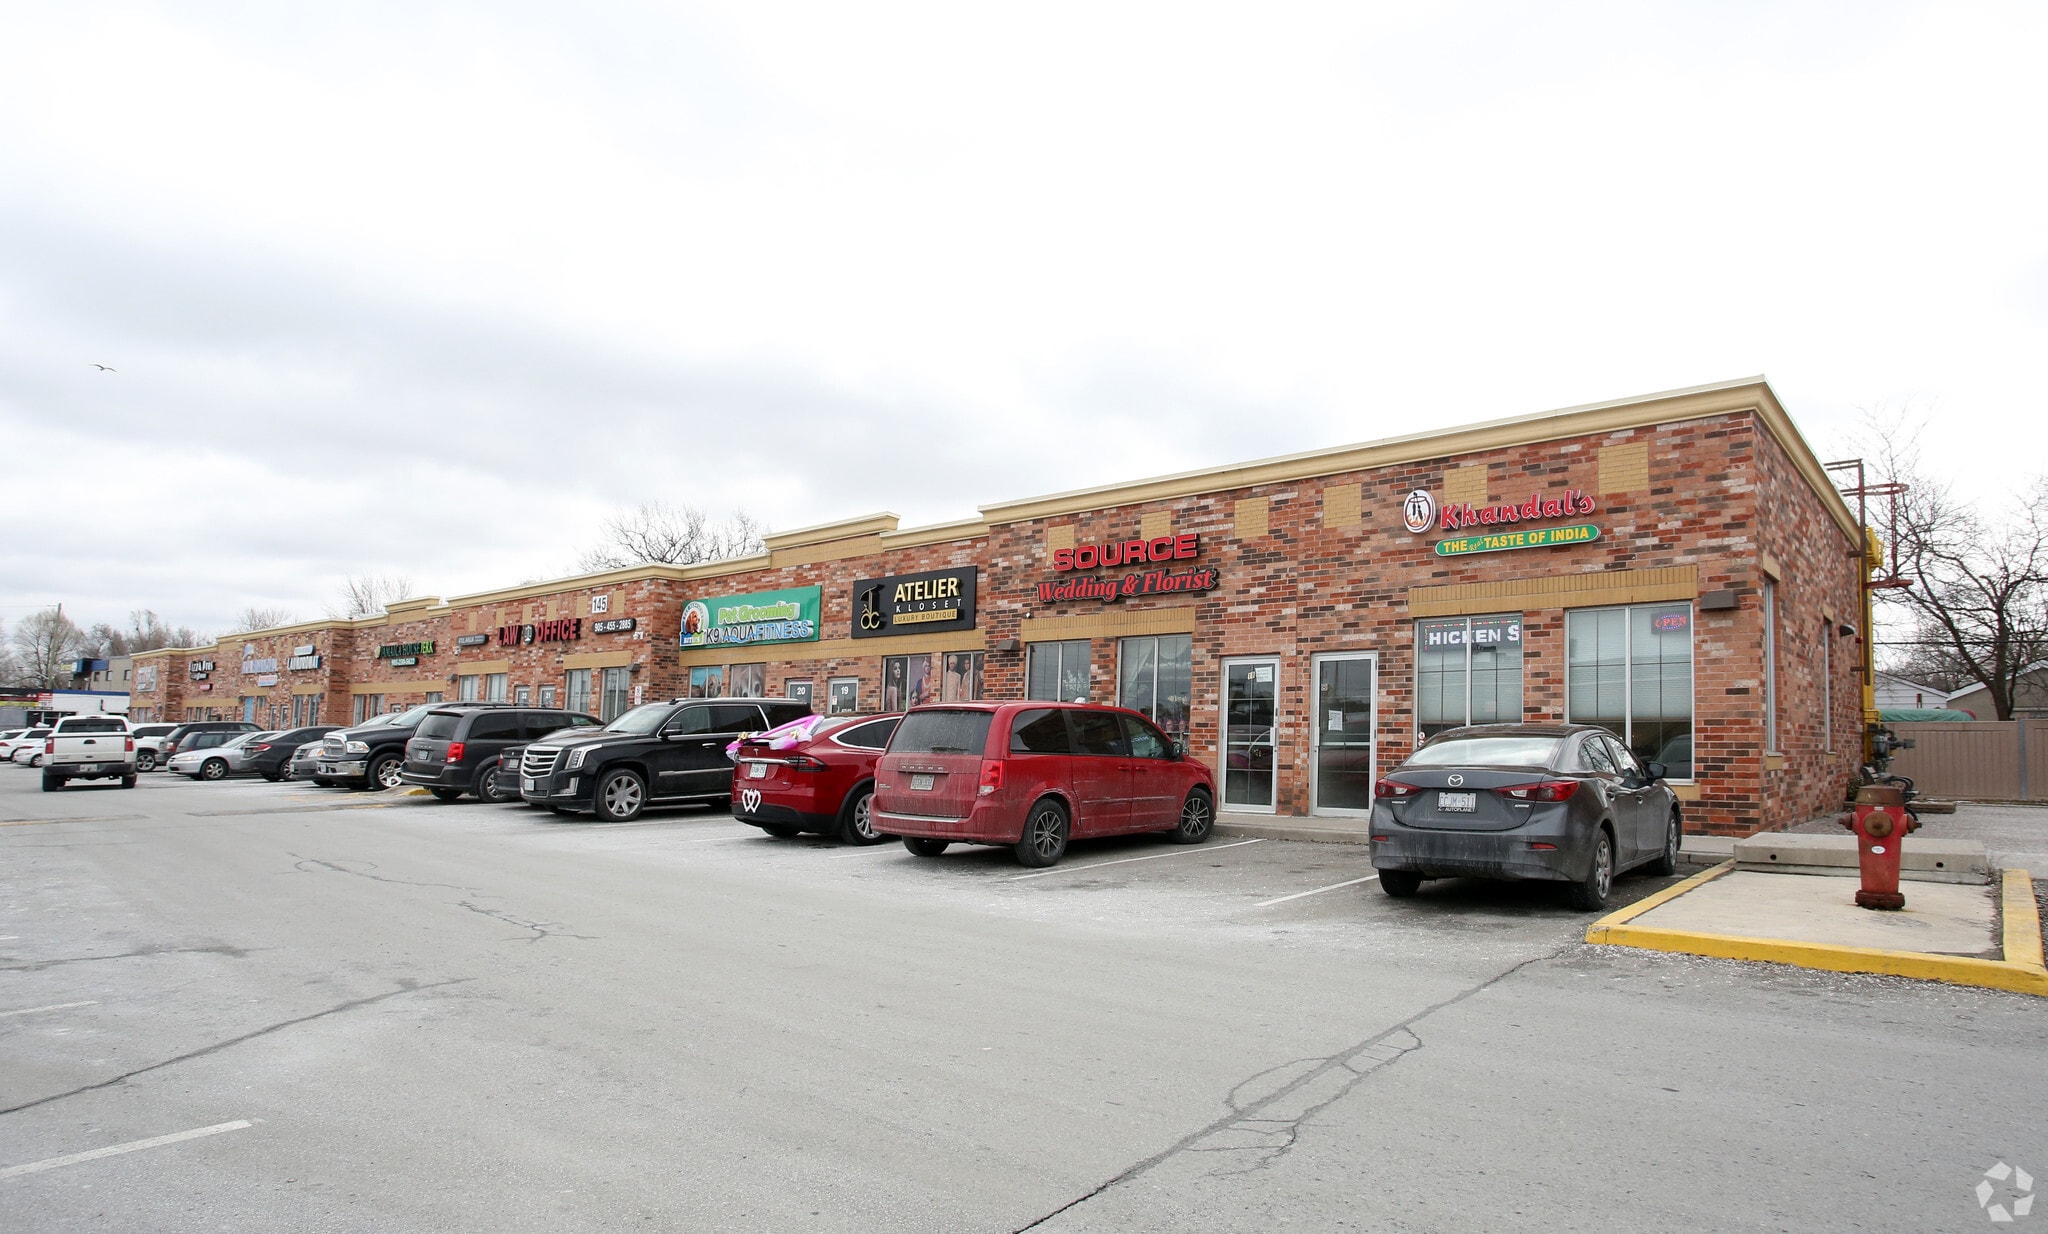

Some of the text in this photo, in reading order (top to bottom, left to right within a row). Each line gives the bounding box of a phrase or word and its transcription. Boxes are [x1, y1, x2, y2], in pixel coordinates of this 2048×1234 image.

[1439, 489, 1595, 530] Khandal's
[1443, 527, 1589, 553] THE Real TASTE OF INDIA
[1053, 533, 1199, 572] SOURCE
[893, 577, 960, 603] ATELIER
[1037, 568, 1214, 602] Wedding & Florist
[592, 597, 607, 612] 145
[718, 607, 738, 624] Pet
[738, 601, 798, 622] Grooming
[896, 598, 962, 613] KLOSET
[894, 610, 956, 623] LUXURY BOUTIQUE
[497, 618, 579, 646] LAW OFFICE
[706, 628, 720, 644] K9
[796, 686, 806, 695] 20
[841, 686, 849, 695] 19
